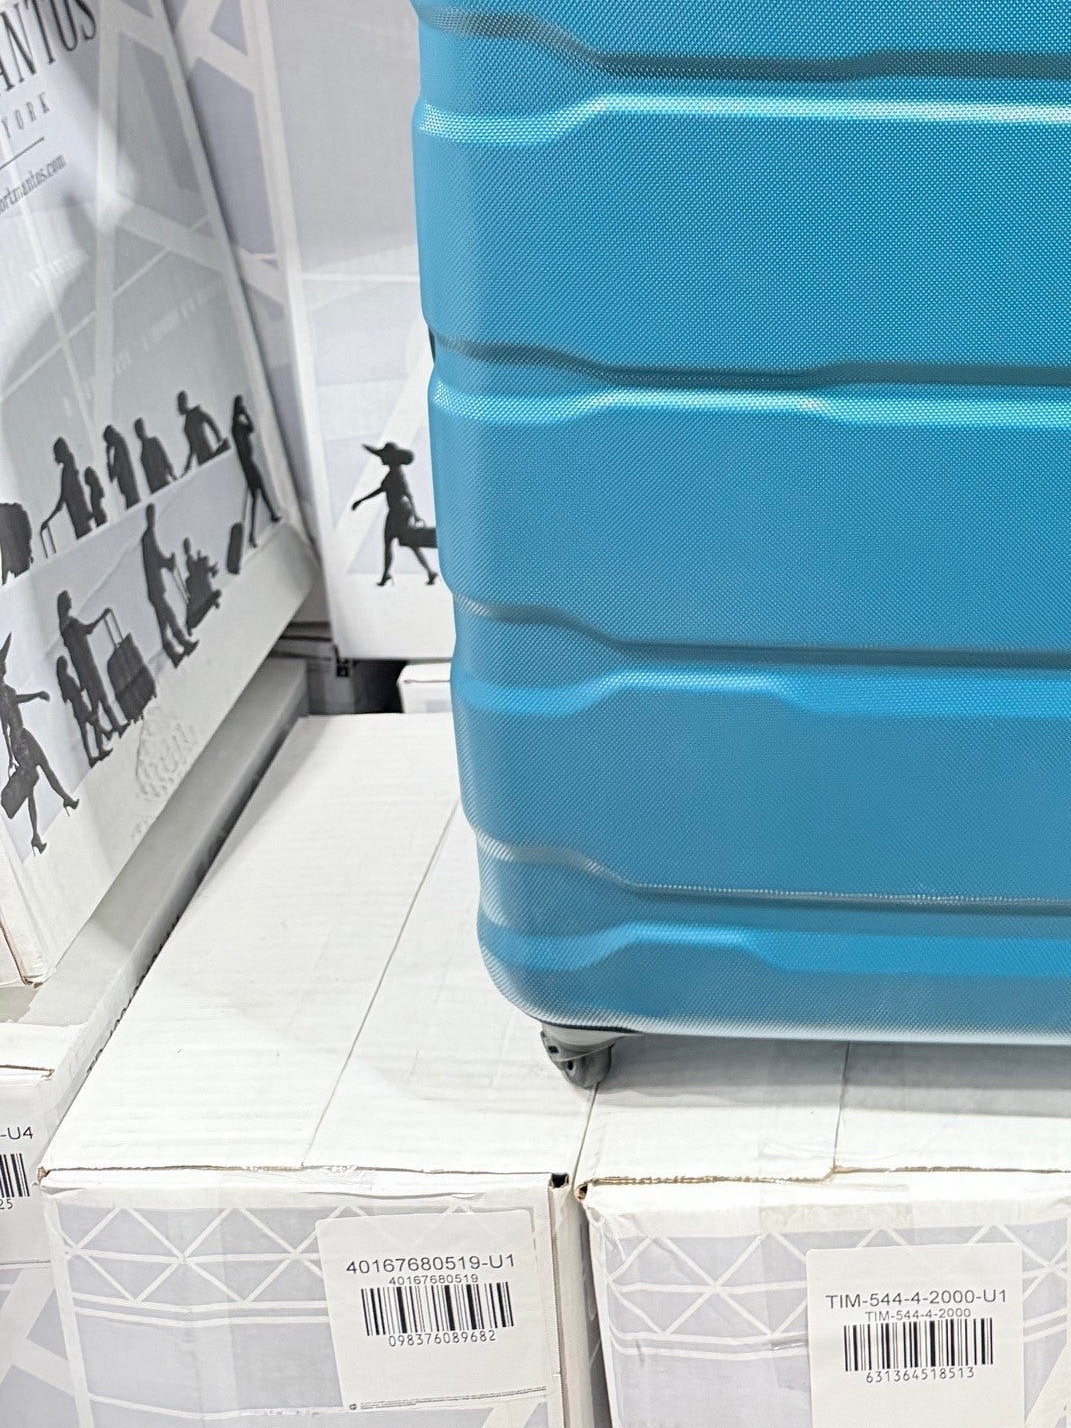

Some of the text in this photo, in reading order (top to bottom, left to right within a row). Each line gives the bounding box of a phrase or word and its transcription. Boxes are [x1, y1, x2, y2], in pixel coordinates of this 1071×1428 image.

[346, 1254, 515, 1274] 40167680519-U1
[389, 1274, 479, 1285] 40167680519
[826, 1289, 1006, 1309] TIM-544-4-2000-U1
[865, 1308, 971, 1322] TIM-544-4-2000
[389, 1329, 496, 1347] 098376089682
[866, 1367, 975, 1383] 631364518513
